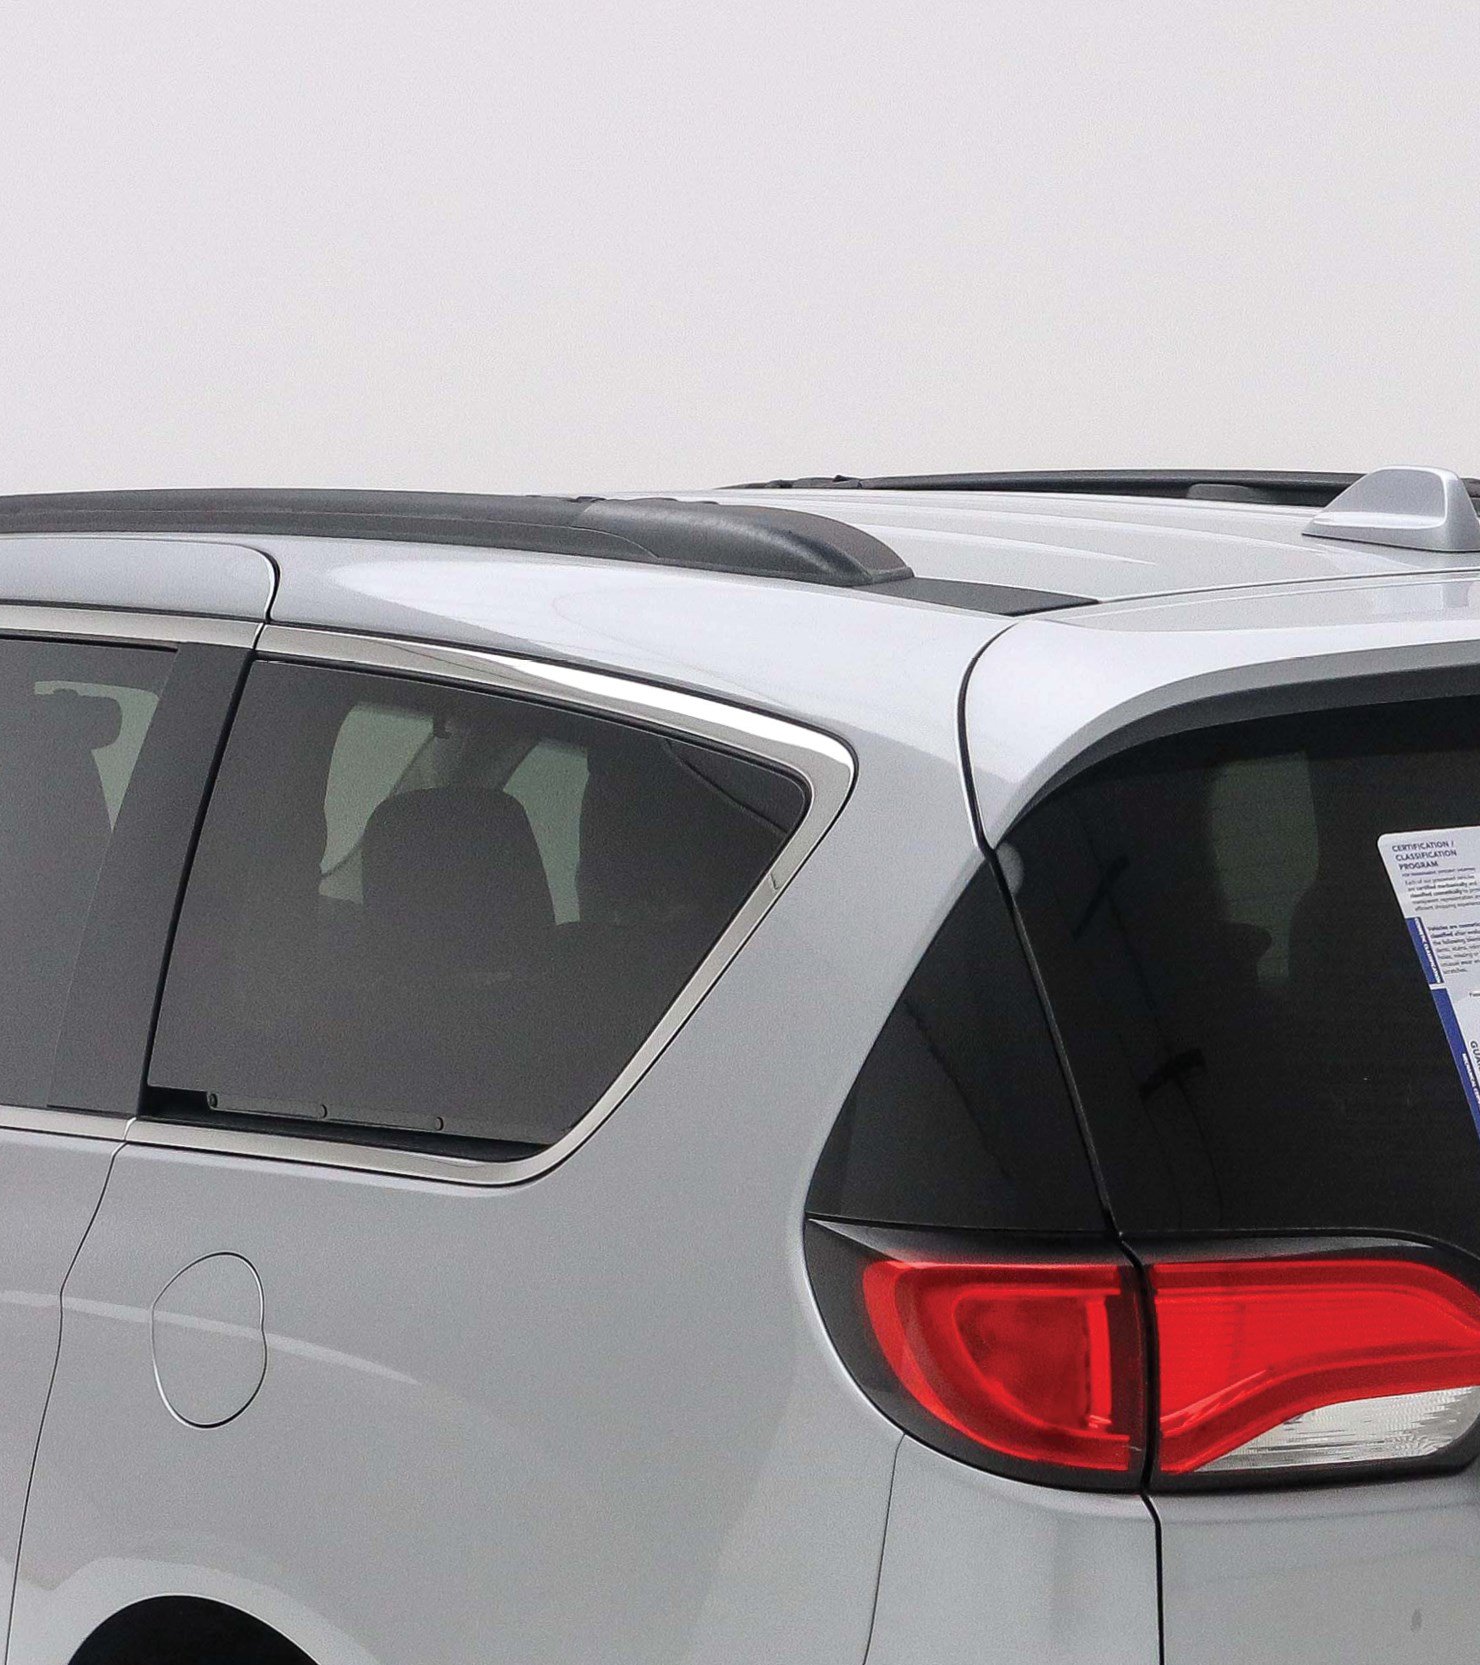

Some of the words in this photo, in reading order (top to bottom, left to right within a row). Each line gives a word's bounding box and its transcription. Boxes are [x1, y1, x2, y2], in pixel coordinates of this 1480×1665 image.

[1392, 842, 1449, 852] CERTIFICATION
[1395, 850, 1457, 860] CLASSIFICATION
[1399, 861, 1438, 870] PROGRAM
